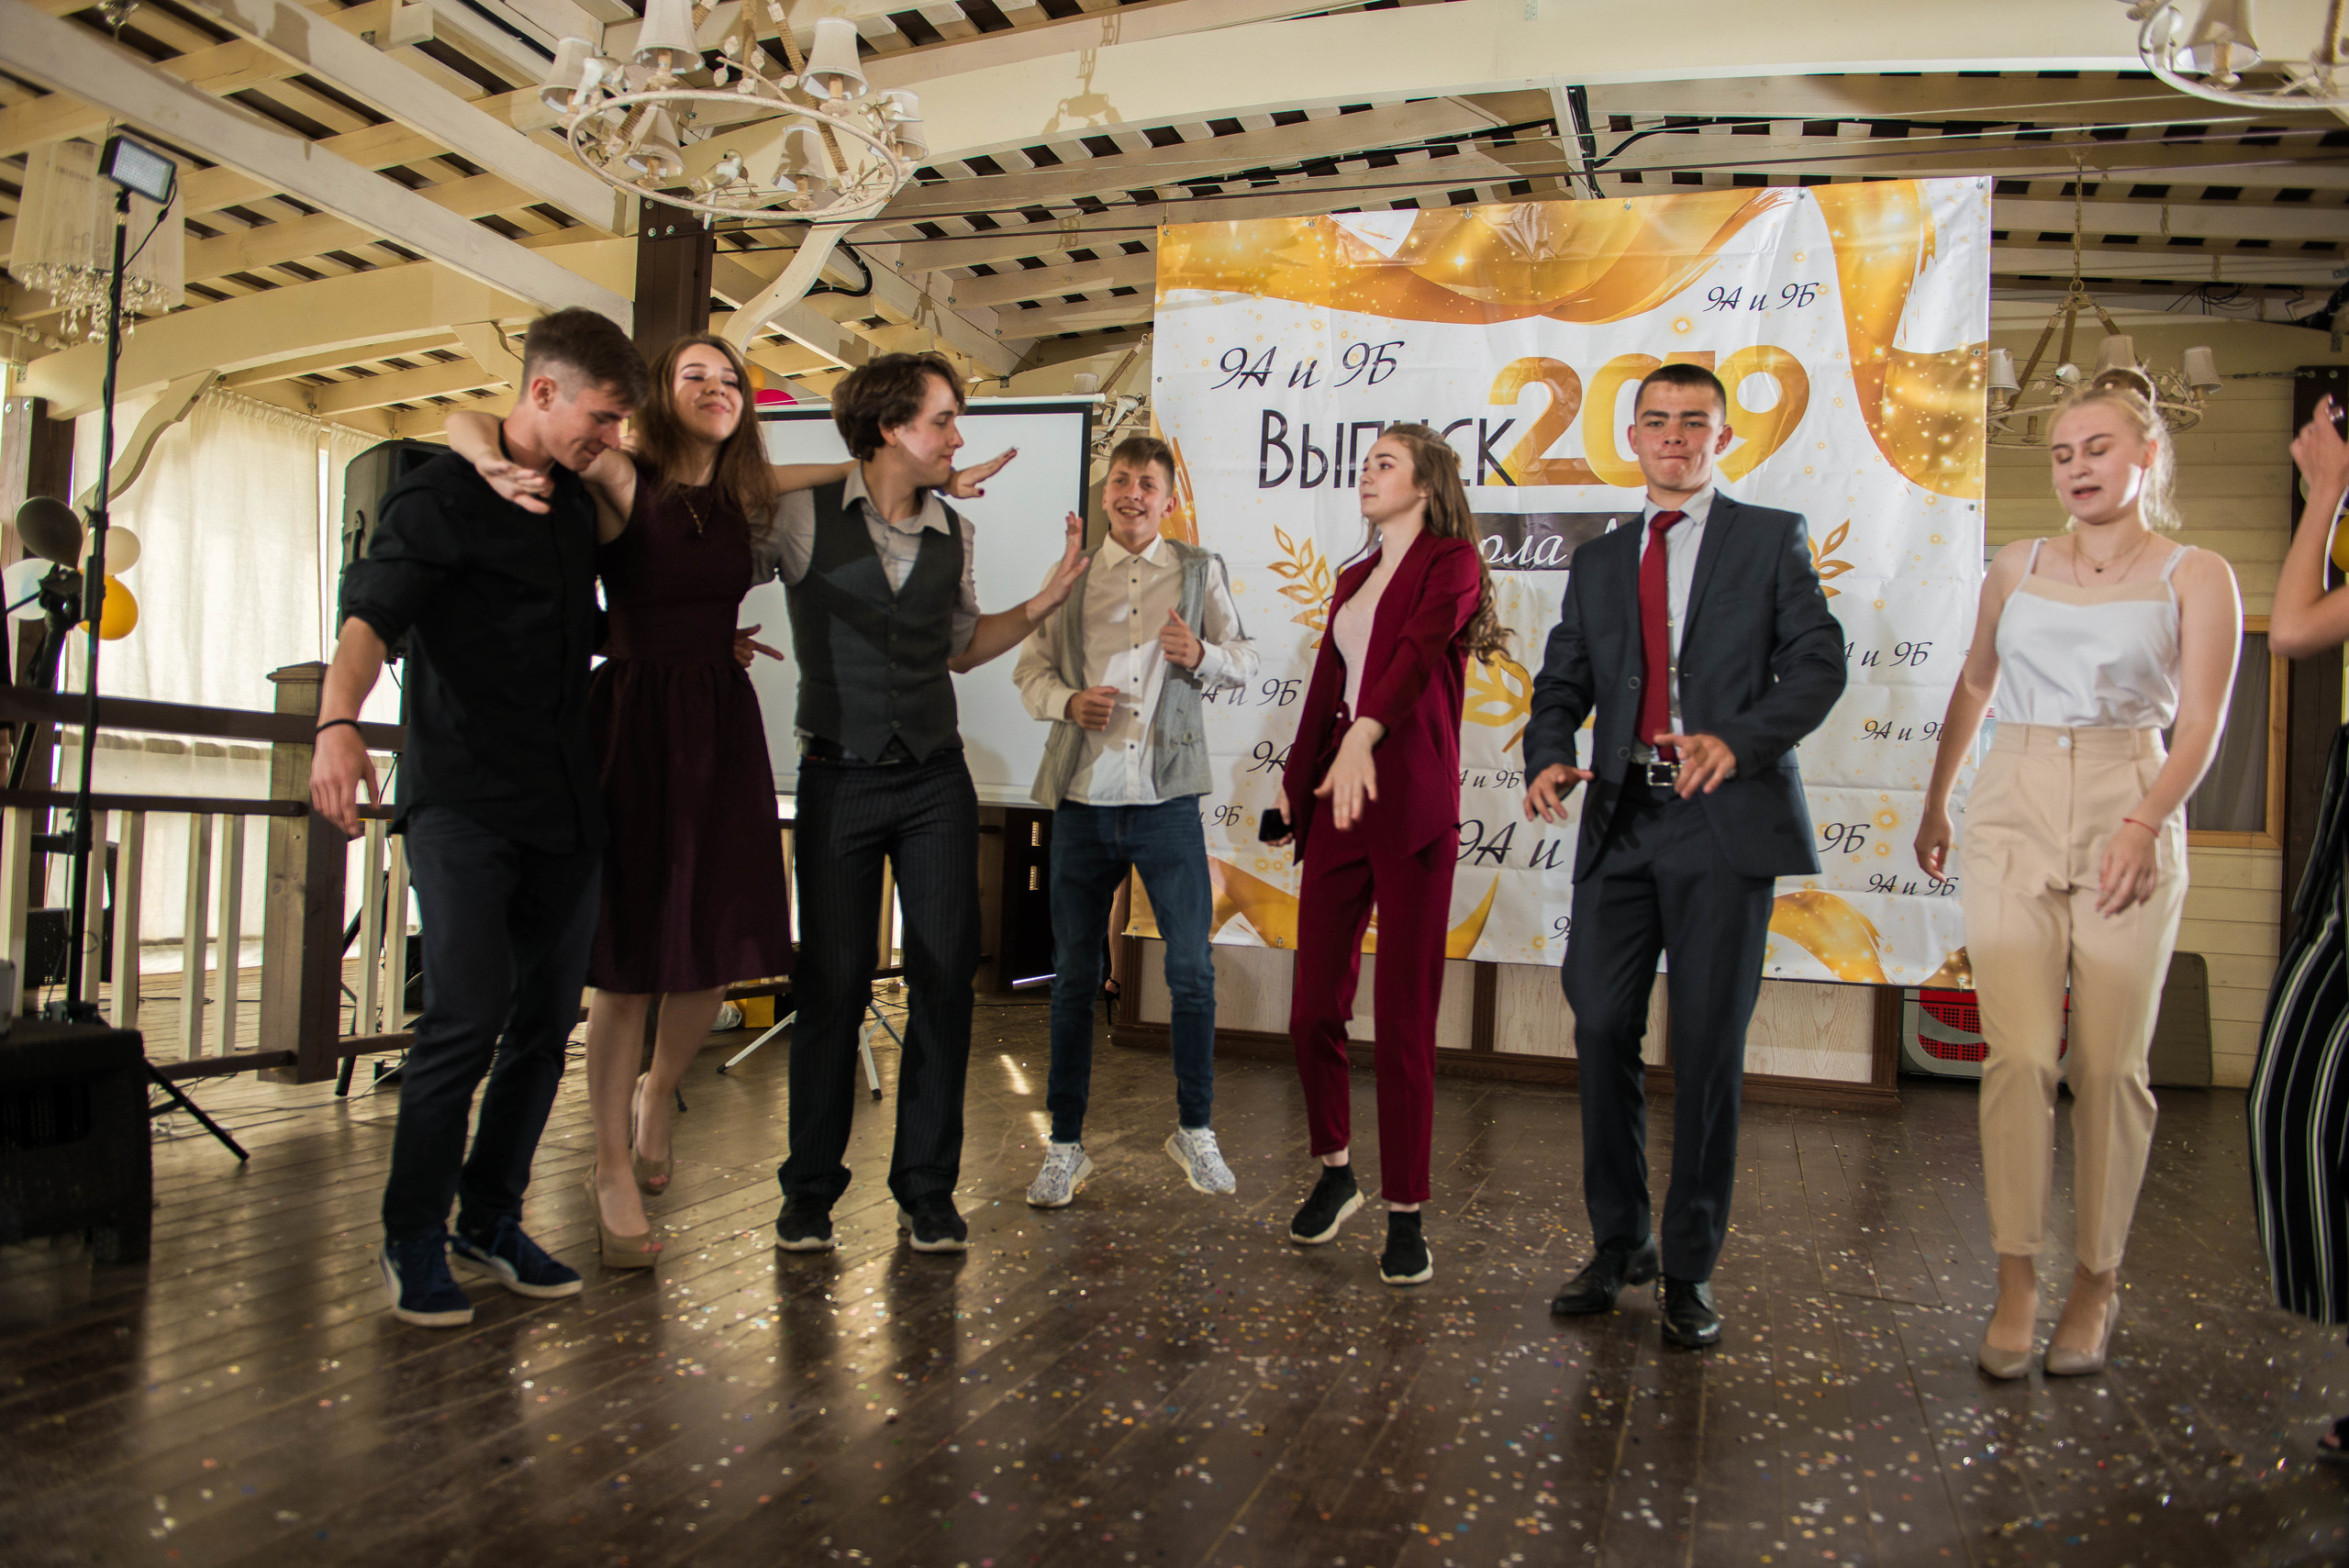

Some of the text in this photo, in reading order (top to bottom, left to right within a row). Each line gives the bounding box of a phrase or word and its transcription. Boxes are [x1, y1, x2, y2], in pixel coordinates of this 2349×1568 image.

[1702, 283, 1820, 312] 9А и 9Б
[1210, 340, 1406, 390] 9А и 9Б
[1484, 344, 1810, 488] 209
[1861, 650, 1882, 667] и
[1888, 641, 1933, 667] 9Б
[1256, 678, 1302, 706] 9Б
[1860, 720, 1893, 740] 9А
[1897, 728, 1913, 741] и
[1472, 775, 1486, 788] и
[1492, 770, 1523, 789] 9Б
[1210, 805, 1243, 827] 9Б
[1456, 819, 1564, 870] 9А и
[1817, 822, 1871, 854] 9Б
[1865, 873, 1959, 896] 9А и 9Б
[1549, 917, 1572, 940] 9
